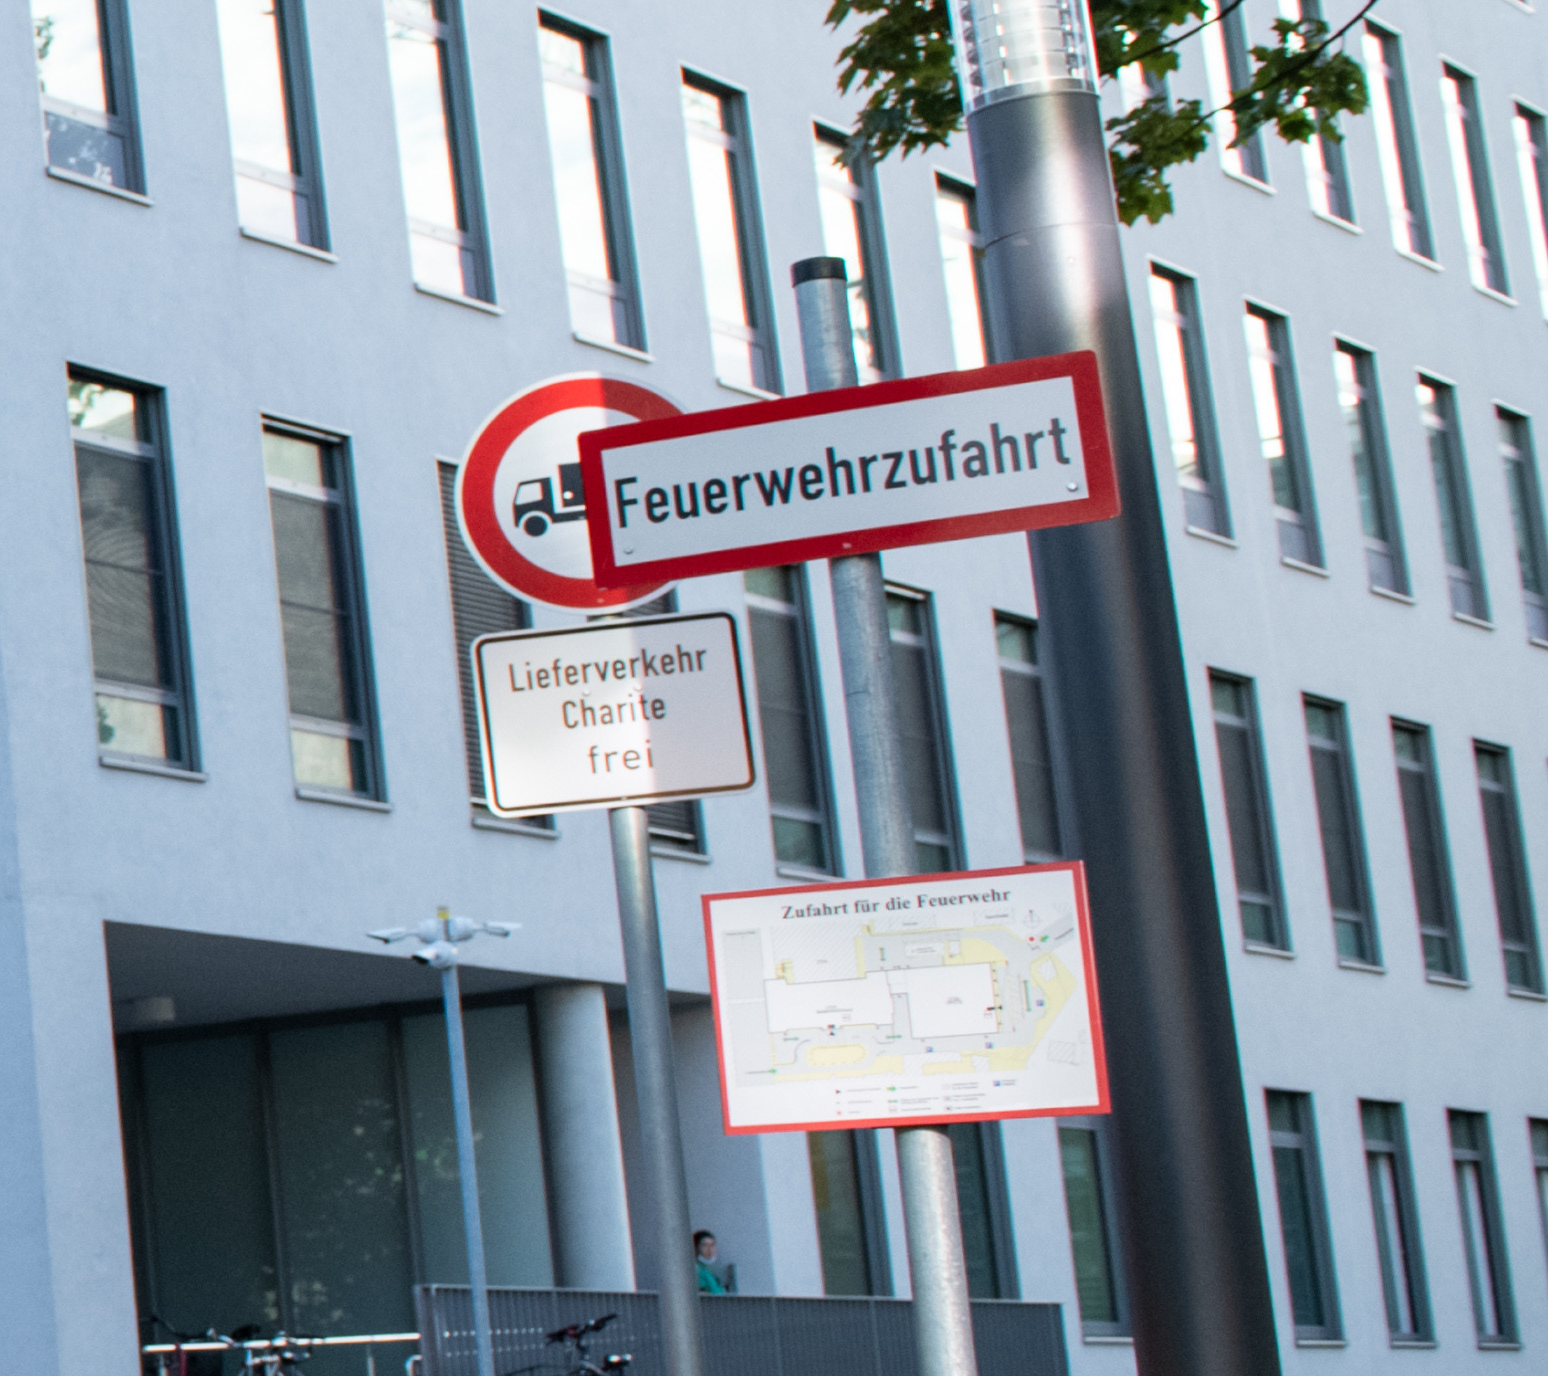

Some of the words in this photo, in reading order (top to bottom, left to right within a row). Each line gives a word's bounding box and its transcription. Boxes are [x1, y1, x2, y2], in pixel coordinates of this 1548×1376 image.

[613, 417, 1071, 528] Feuerwehrzufahrt
[508, 643, 707, 692] Lieferverkehr
[561, 693, 666, 729] Charite
[587, 738, 654, 774] frei
[782, 901, 849, 920] Zufahrt
[854, 899, 880, 914] für
[885, 895, 912, 911] die
[916, 888, 1011, 909] Feuerwehr
